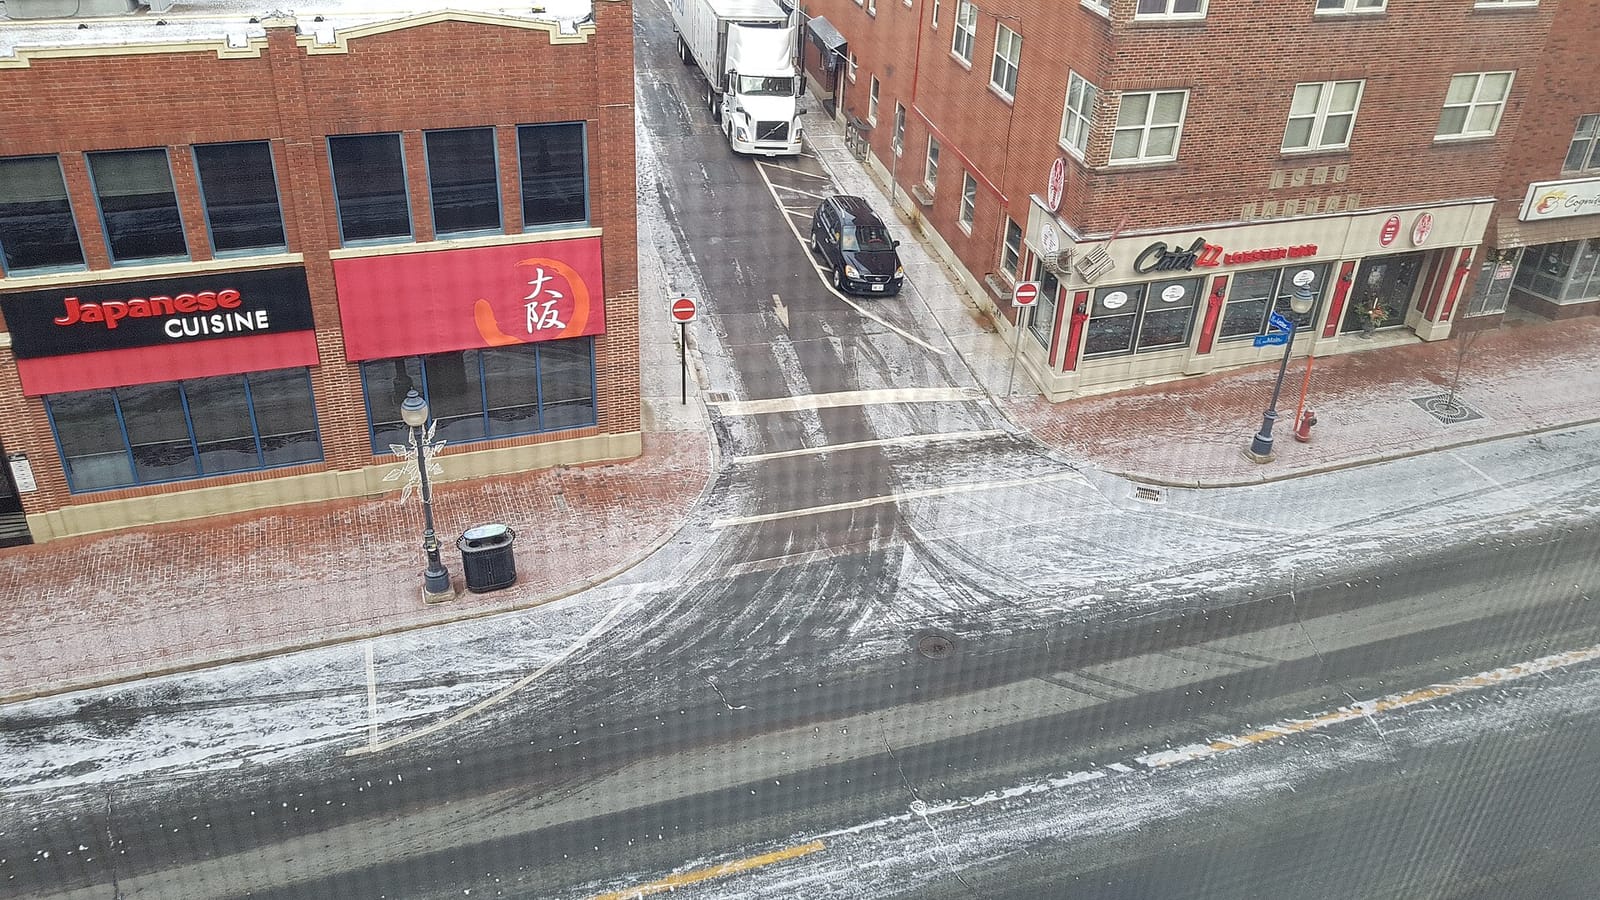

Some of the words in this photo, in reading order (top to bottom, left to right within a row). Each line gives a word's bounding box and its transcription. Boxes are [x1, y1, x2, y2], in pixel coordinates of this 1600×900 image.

[1271, 165, 1348, 188] 1940
[1134, 236, 1206, 274] Catch
[1195, 242, 1223, 267] 22
[1224, 247, 1287, 266] LOBSTER
[1287, 244, 1318, 259] BAR
[54, 288, 242, 329] Japanese
[523, 267, 566, 334] 大阪
[164, 310, 269, 338] CUISINE
